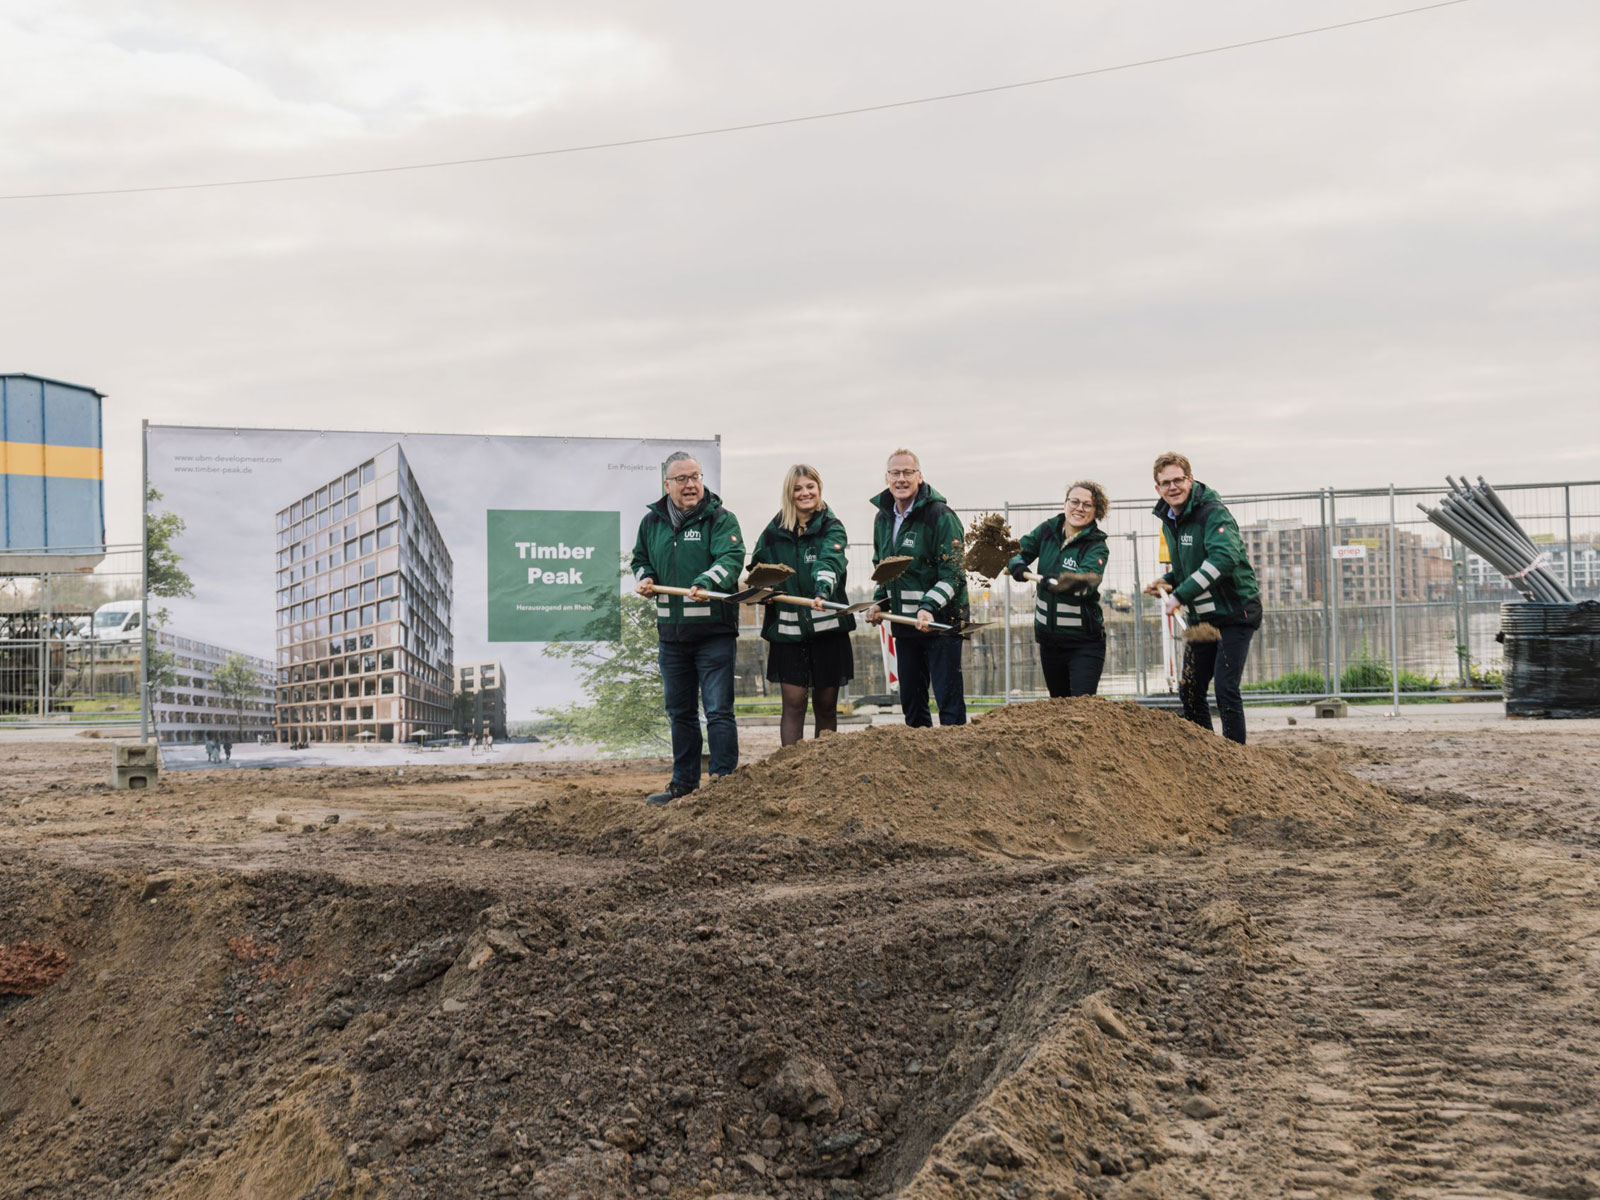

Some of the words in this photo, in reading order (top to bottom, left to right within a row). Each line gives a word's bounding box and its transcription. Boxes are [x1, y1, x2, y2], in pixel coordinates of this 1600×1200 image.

[174, 454, 283, 464] www.ubm-development.com
[174, 466, 253, 475] www.timber-peak.de
[607, 463, 619, 471] Ein
[620, 463, 644, 472] Projekt
[515, 542, 595, 560] Timber
[1337, 548, 1361, 558] griep
[527, 567, 583, 585] Peak
[516, 604, 562, 612] Herausragend
